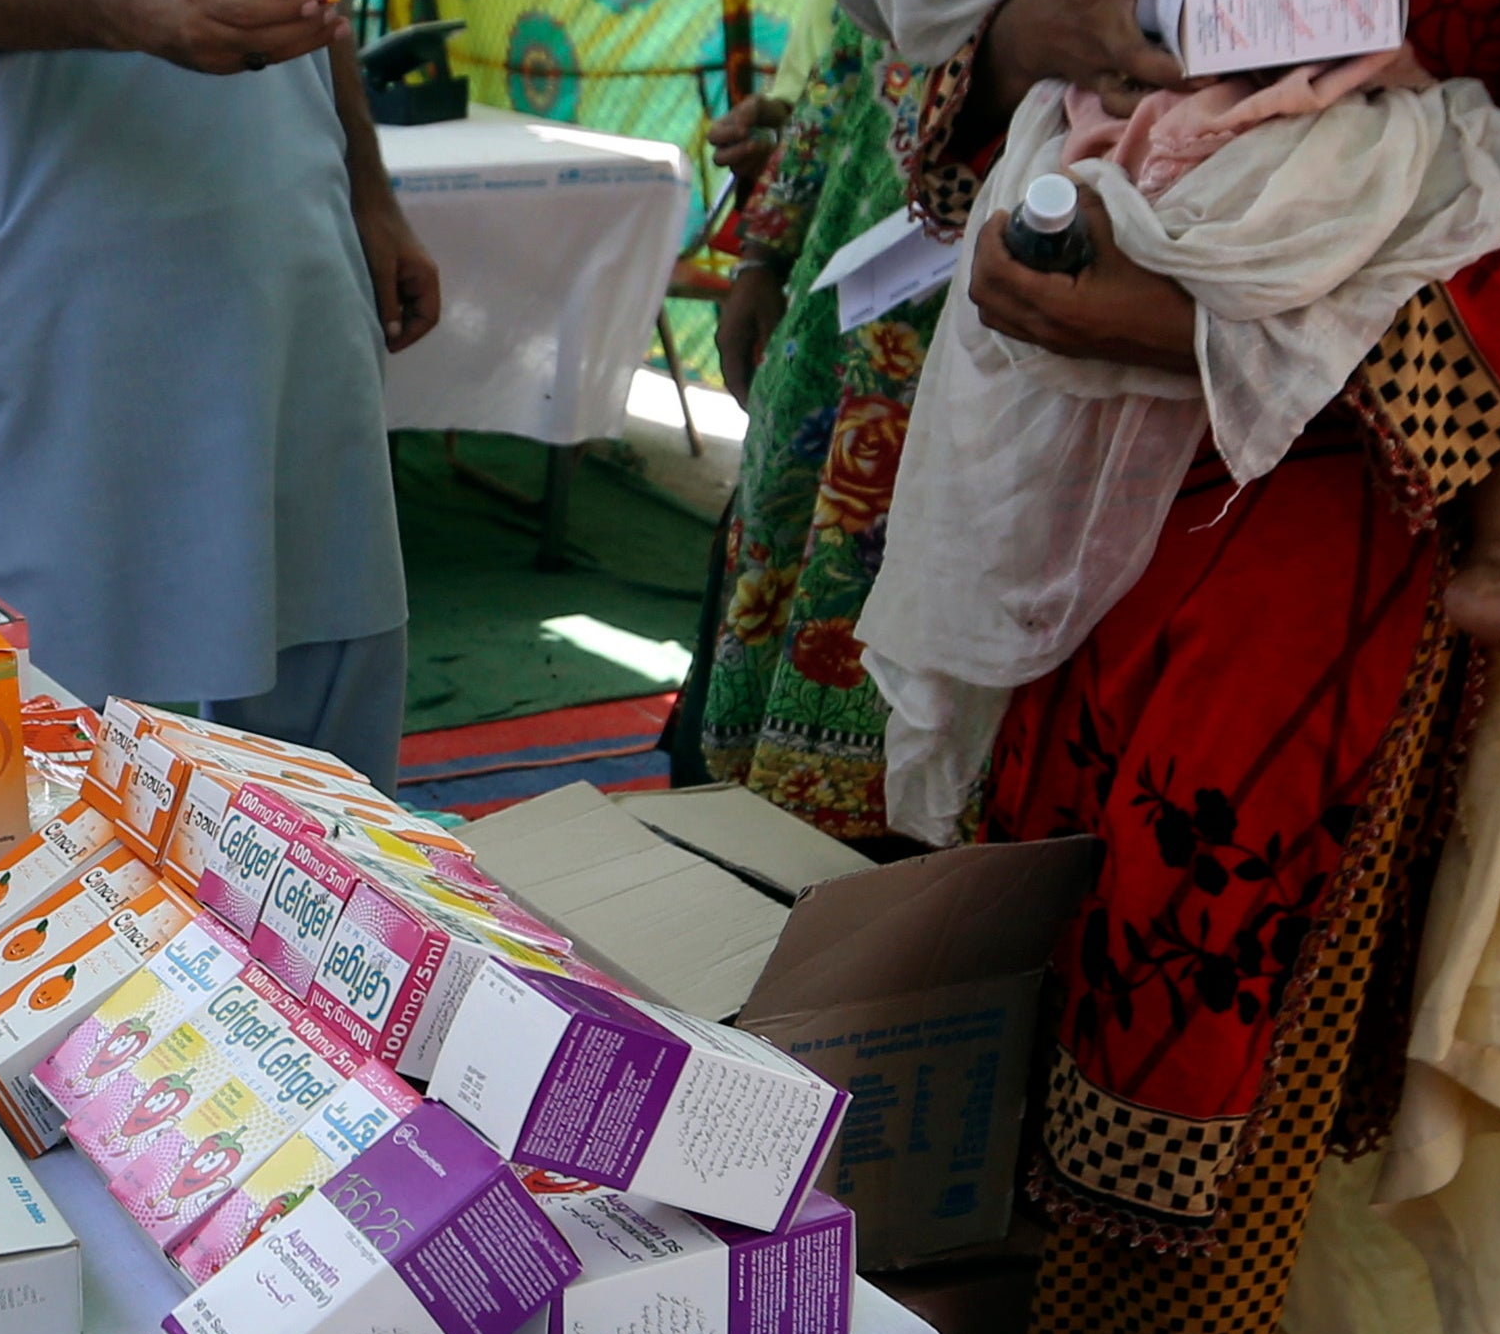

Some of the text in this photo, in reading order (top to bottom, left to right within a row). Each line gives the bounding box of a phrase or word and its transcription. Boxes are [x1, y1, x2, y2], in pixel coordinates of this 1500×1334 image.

[236, 789, 299, 835] 100mg/5ml
[219, 815, 279, 881] Cefiget
[291, 839, 350, 893] 100mg/5ml
[274, 866, 333, 940] Cefiget
[324, 940, 391, 1022] Cefiget
[380, 938, 447, 1061] 100mg/5ml
[206, 985, 280, 1055] Cefiget
[294, 1016, 358, 1077] 100mg/5m
[311, 988, 376, 1051] 100mg/5ml
[257, 1036, 337, 1111] Cefiget
[328, 1172, 417, 1254] 156.25
[584, 1197, 668, 1259] (Co-amoxiclav)
[600, 1192, 684, 1254] Augmentin DS
[261, 1234, 335, 1309] (Co-amoxiclav)
[284, 1228, 341, 1288] Augmentin
